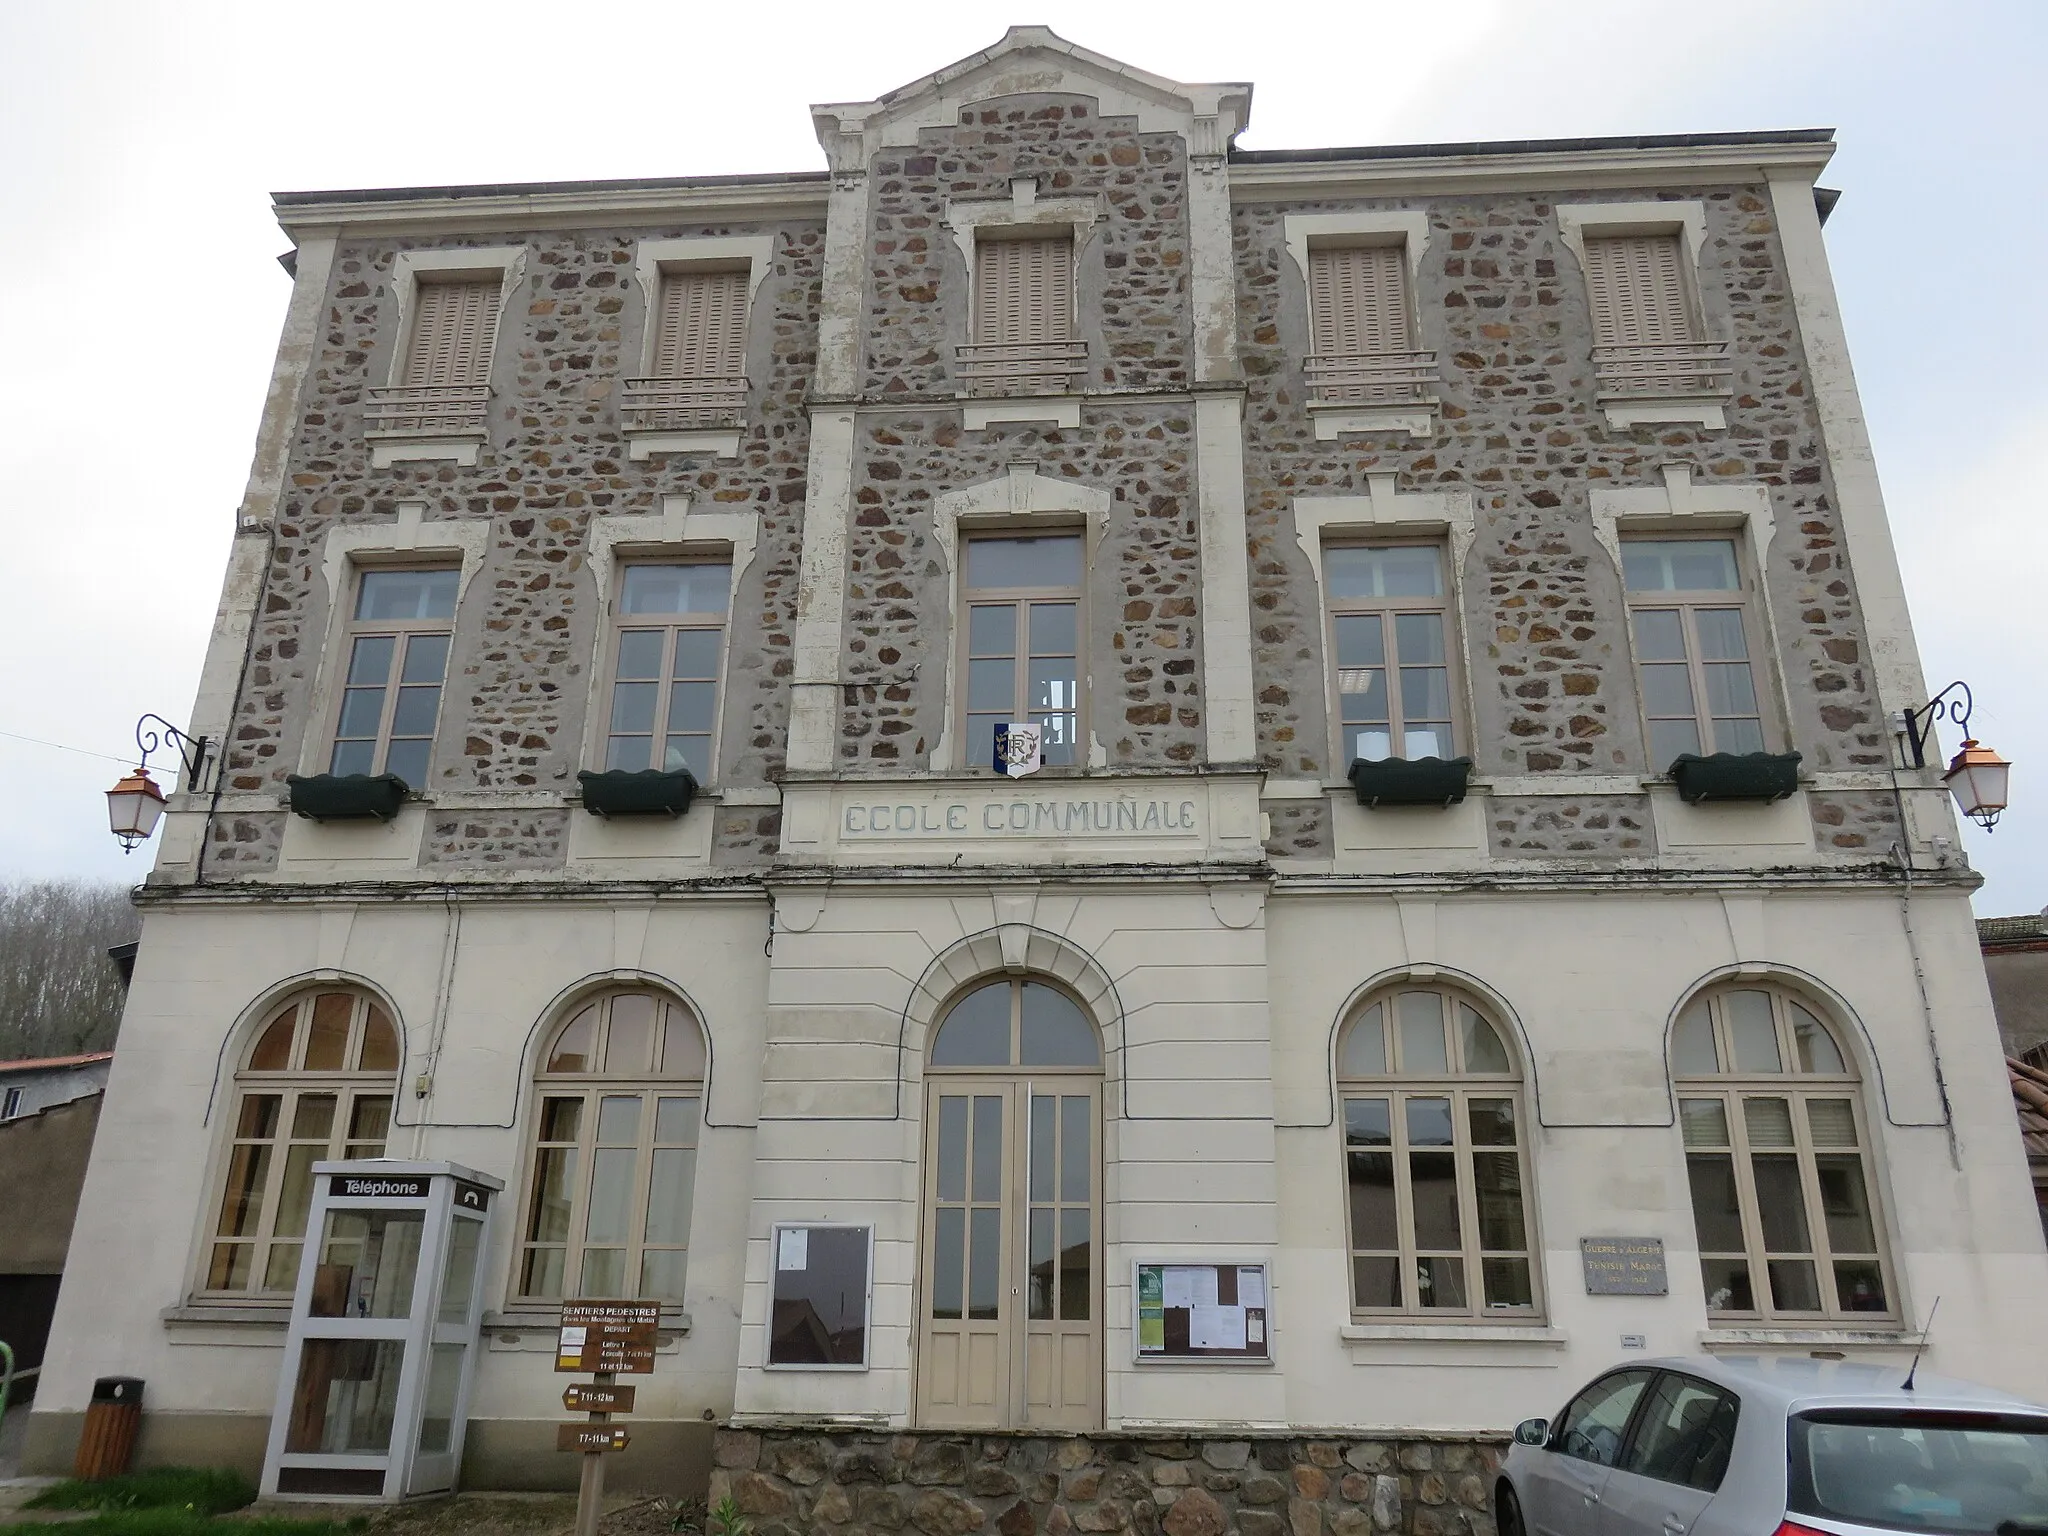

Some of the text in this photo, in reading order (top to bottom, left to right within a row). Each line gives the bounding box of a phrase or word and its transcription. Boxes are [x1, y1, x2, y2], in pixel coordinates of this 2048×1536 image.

[982, 801, 1196, 832] COMMUNALE
[345, 1180, 419, 1196] Téléphone
[563, 1306, 657, 1316] SENTIERS PEDESTRES
